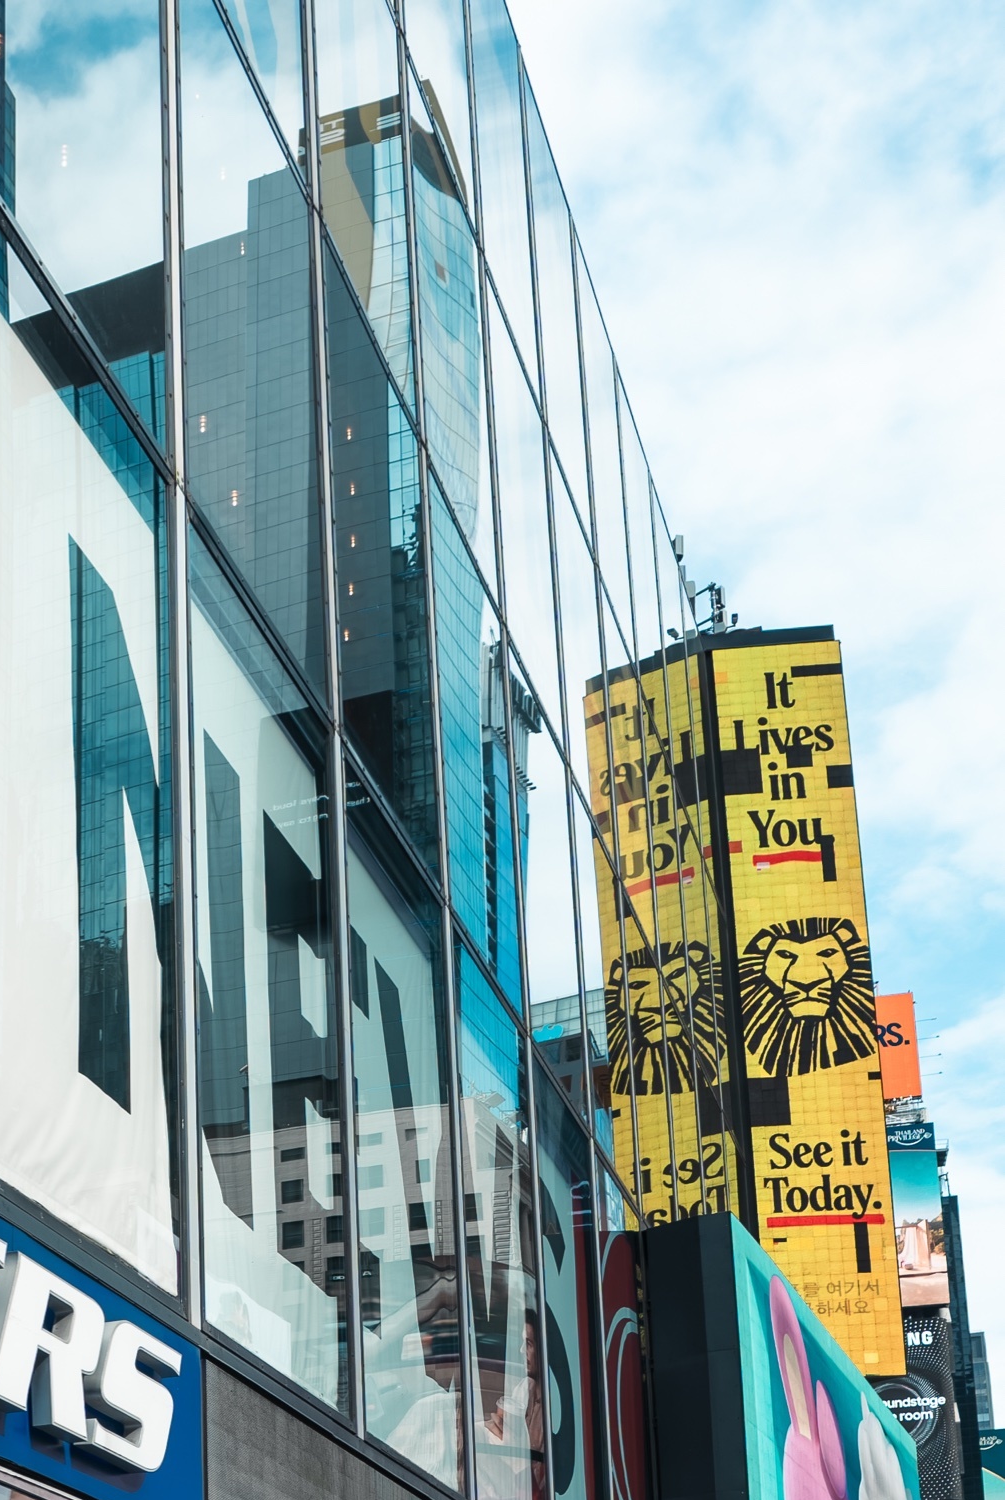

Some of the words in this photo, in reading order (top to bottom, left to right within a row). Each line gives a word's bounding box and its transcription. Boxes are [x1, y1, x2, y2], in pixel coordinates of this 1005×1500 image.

[764, 671, 796, 709] It
[733, 717, 835, 755] Lives
[767, 761, 806, 801] in
[747, 809, 824, 848] You
[769, 1133, 834, 1170] See
[840, 1129, 869, 1166] it
[763, 1175, 883, 1219] Today.
[826, 1279, 880, 1297] 여기서
[899, 1410, 934, 1422] room
